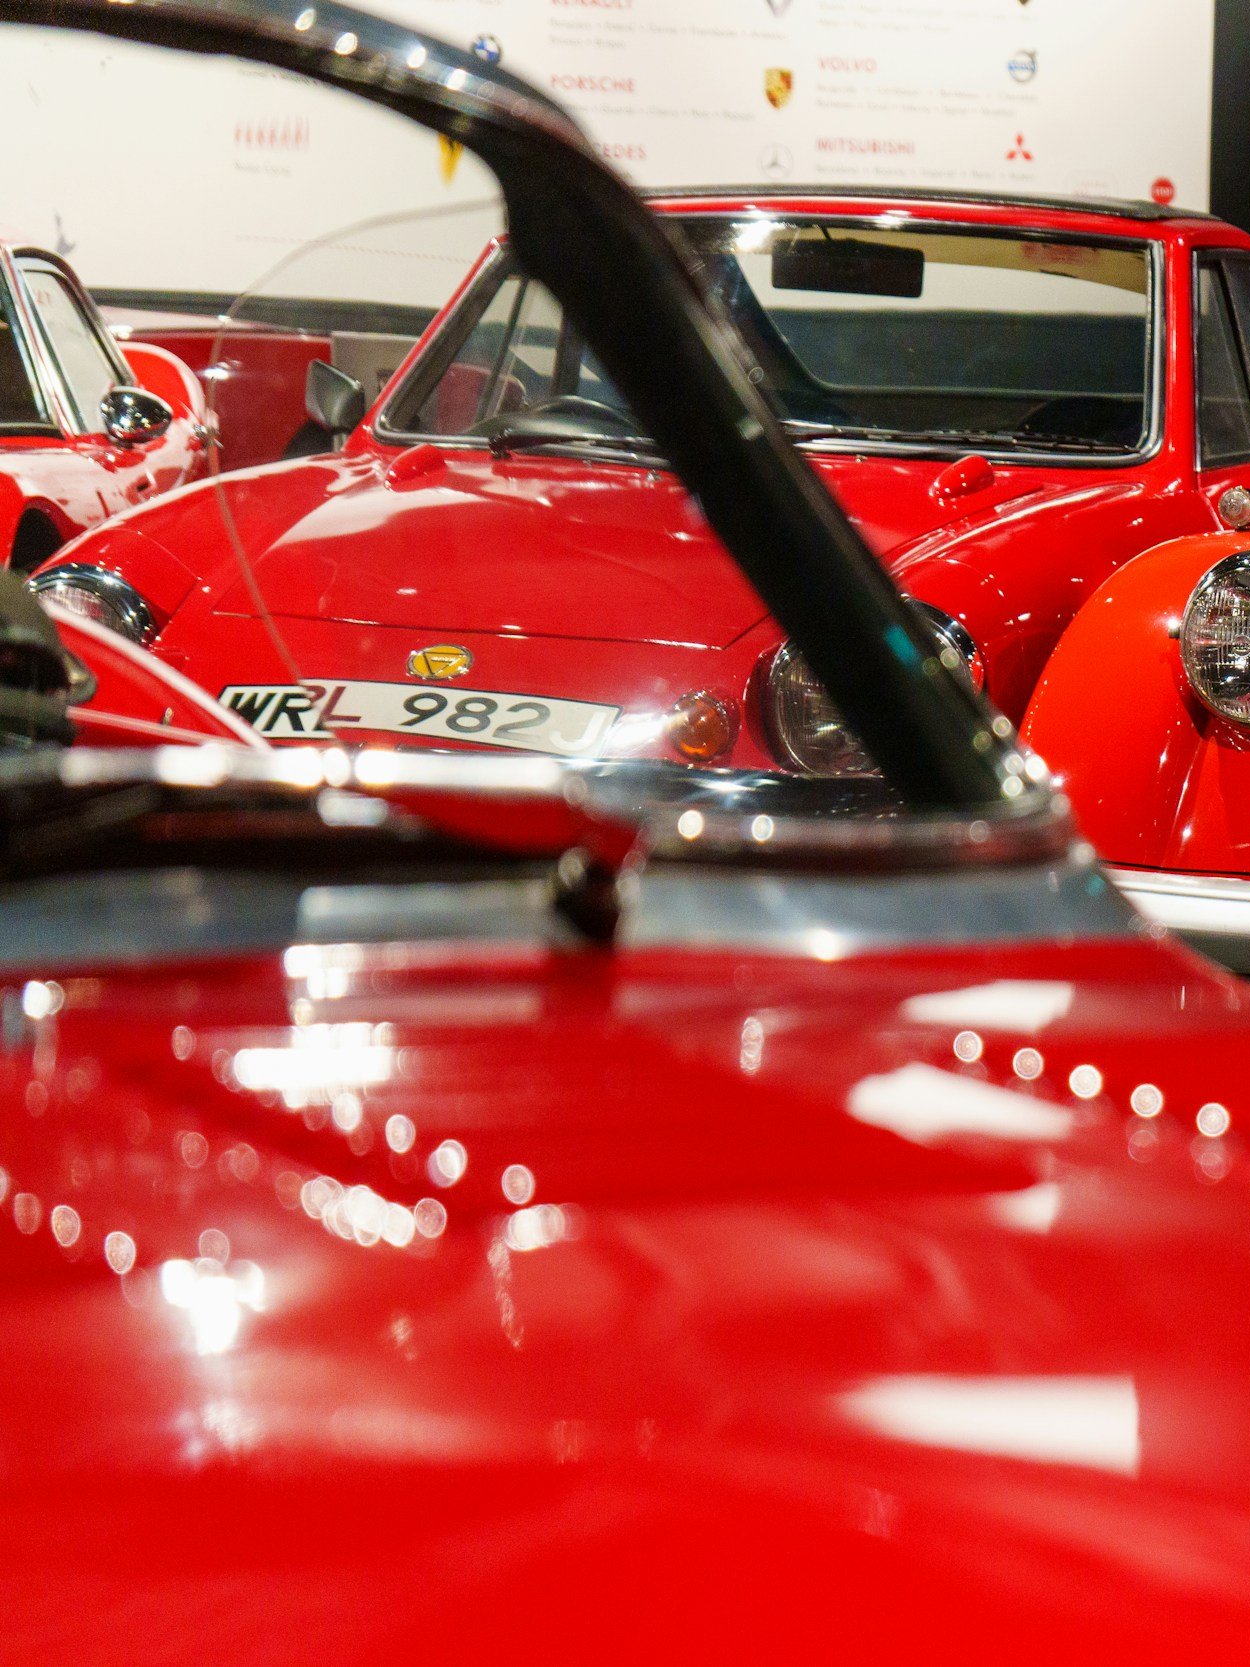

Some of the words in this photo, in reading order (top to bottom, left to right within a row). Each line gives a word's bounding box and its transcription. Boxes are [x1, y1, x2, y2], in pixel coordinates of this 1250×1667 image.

[818, 56, 878, 74] VOLVO
[550, 75, 636, 93] PORSCHE
[816, 136, 916, 155] MITSUBISHI
[229, 684, 361, 738] WRL
